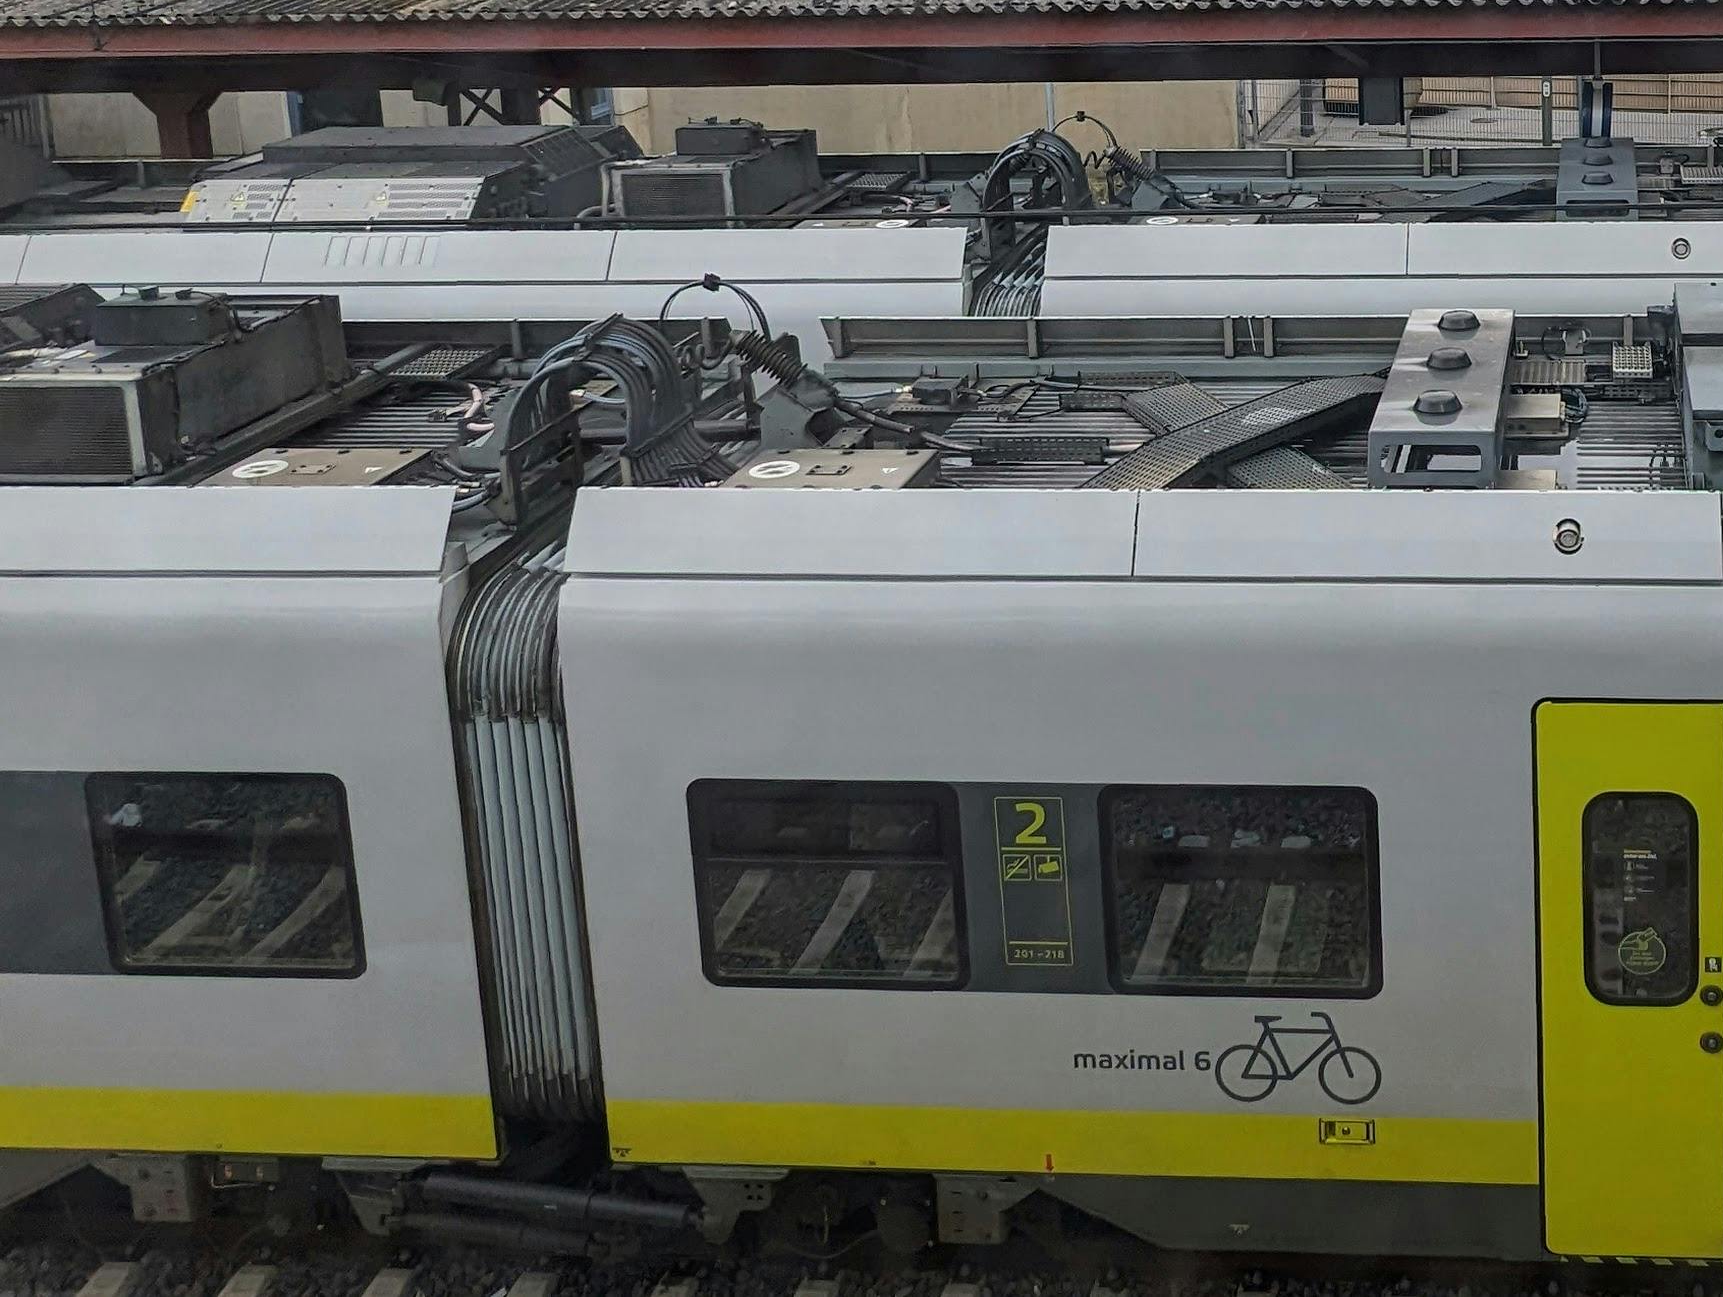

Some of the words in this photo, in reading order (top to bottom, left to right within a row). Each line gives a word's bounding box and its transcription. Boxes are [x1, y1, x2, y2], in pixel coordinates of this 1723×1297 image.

[1015, 802, 1047, 844] 2
[1073, 1048, 1186, 1070] maximal
[1194, 1050, 1212, 1071] 6
